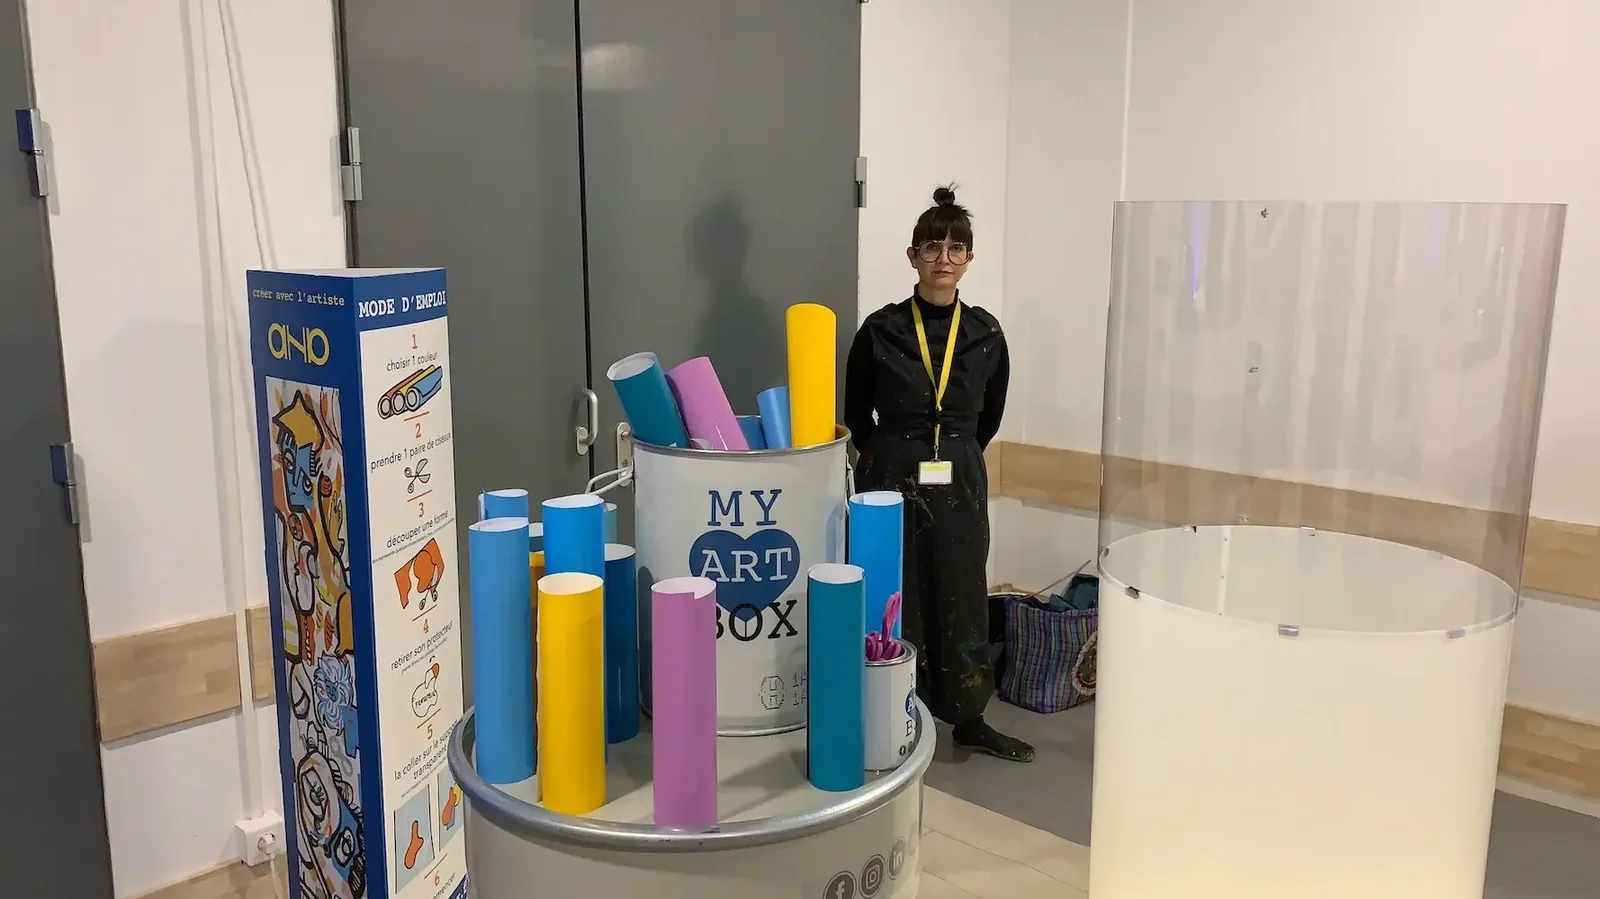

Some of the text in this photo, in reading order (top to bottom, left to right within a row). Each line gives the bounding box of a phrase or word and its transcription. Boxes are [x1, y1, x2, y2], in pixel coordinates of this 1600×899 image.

[253, 288, 345, 306] créer avec l'artiste
[358, 290, 447, 318] MODE D'EMPLOI
[412, 334, 418, 349] 1
[386, 351, 438, 372] choisir 1 couleur
[415, 423, 422, 438] 2
[370, 452, 402, 473] prendre
[404, 448, 408, 459] 1
[410, 444, 426, 460] paire
[426, 439, 434, 450] de
[418, 502, 424, 518] 3
[707, 489, 782, 527] MY
[386, 525, 421, 548] découper
[422, 519, 433, 532] une
[433, 510, 448, 525] forme
[701, 547, 793, 583] ART
[716, 599, 798, 642] OX
[391, 650, 413, 671] retirer
[414, 643, 426, 657] son
[426, 620, 454, 650] protecteur
[427, 723, 433, 740] 5
[394, 770, 401, 781] la
[402, 755, 422, 775] coller
[422, 745, 433, 759] sur
[433, 739, 439, 749] le
[413, 744, 447, 780] transparent
[434, 870, 440, 886] 6
